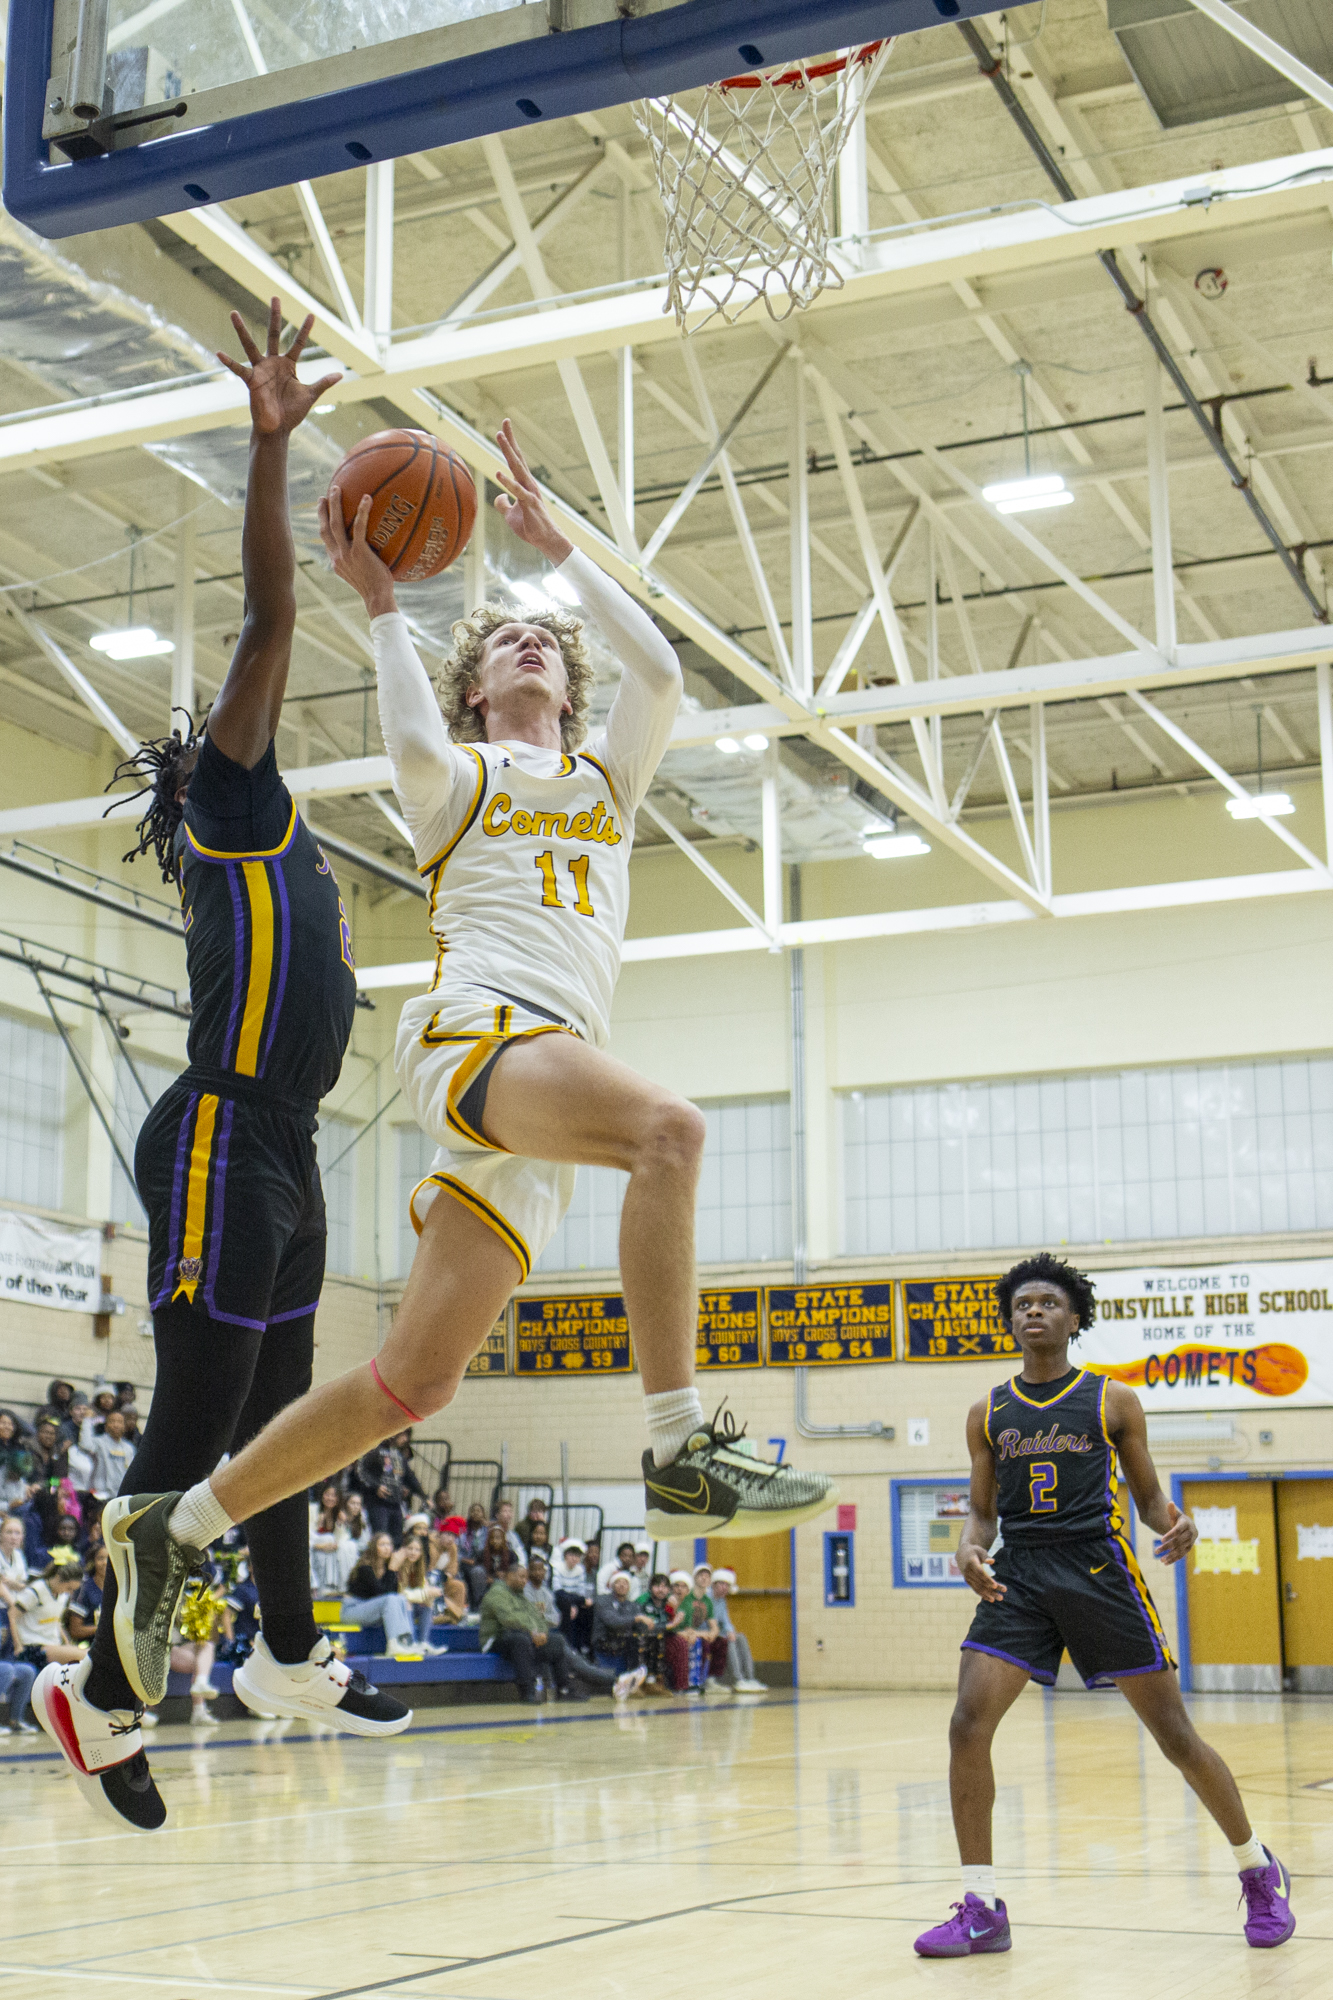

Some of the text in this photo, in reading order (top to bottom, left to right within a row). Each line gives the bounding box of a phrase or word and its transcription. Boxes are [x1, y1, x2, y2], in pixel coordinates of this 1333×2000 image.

[371, 493, 416, 549] DING
[482, 792, 622, 846] Comets
[534, 850, 595, 917] 11
[6, 1275, 88, 1302] of the Year
[1143, 1274, 1250, 1293] WELCOME TO
[794, 1288, 863, 1308] STATE
[1205, 1292, 1249, 1317] HIGH
[1259, 1288, 1333, 1313] SCHOOL
[543, 1301, 604, 1319] STATE
[770, 1305, 889, 1327] CHAMPIONS
[908, 1300, 1000, 1320] CHAMPIO
[519, 1317, 628, 1337] CHAMPIONS
[698, 1311, 757, 1330] PIONS
[933, 1318, 1007, 1337] BASEBALL
[709, 1329, 757, 1345] COUNTRY
[804, 1326, 838, 1342] CROSS
[840, 1324, 889, 1340] COUNTRY
[1143, 1322, 1256, 1341] HOME OF THE
[550, 1337, 580, 1351] CROSS
[583, 1335, 627, 1350] COUNTRY
[787, 1340, 873, 1360] 19 64
[928, 1334, 1015, 1355] 19 76
[535, 1351, 613, 1369] 19 59
[718, 1345, 741, 1362] 60
[1144, 1350, 1257, 1388] COMETS
[767, 1438, 786, 1464] 7
[997, 1423, 1092, 1460] Raiders
[1029, 1461, 1058, 1513] 2
